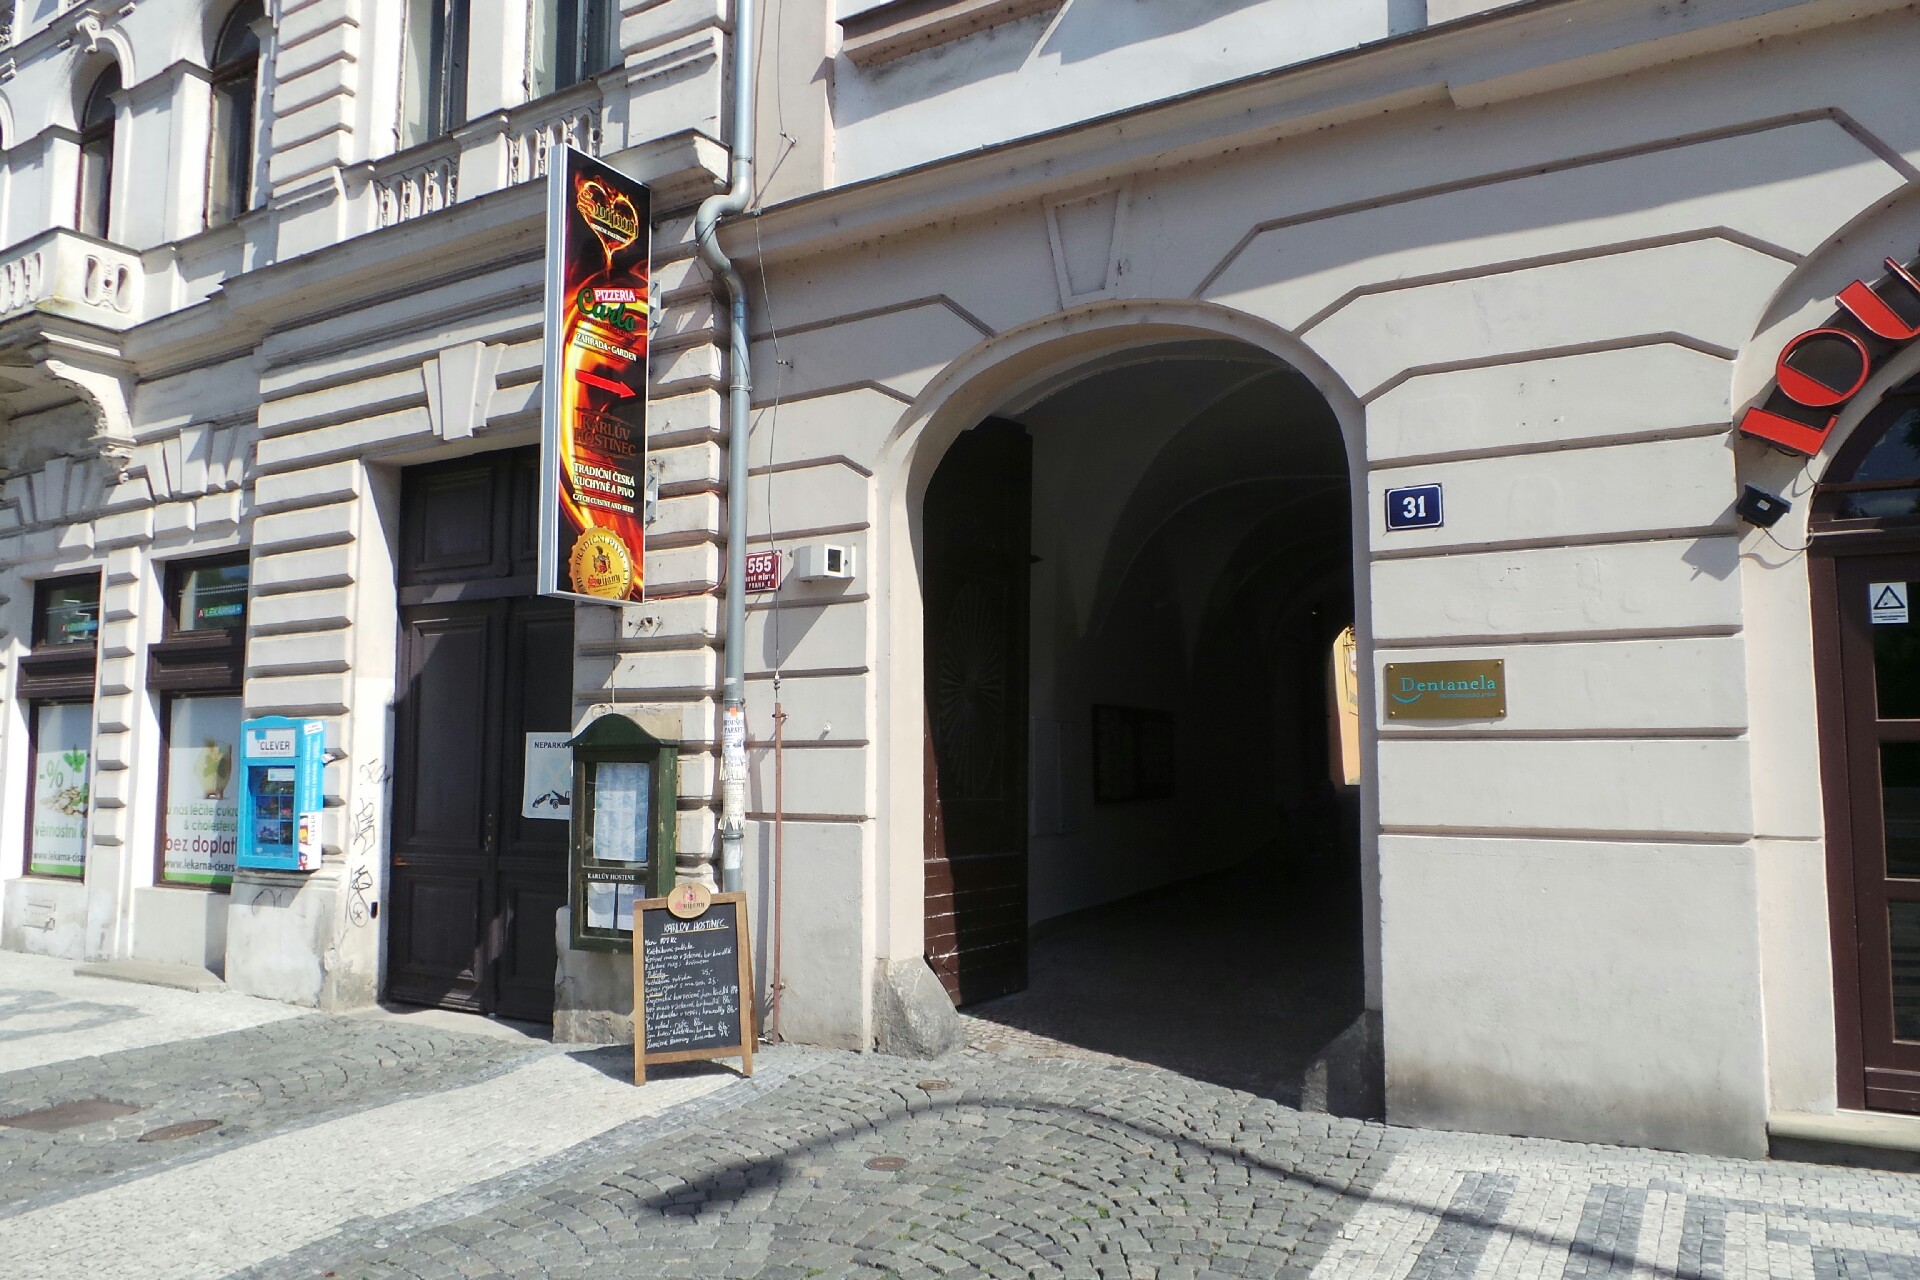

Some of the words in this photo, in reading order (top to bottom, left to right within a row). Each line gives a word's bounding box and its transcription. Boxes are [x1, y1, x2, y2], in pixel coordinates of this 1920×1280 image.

[594, 290, 635, 302] PIZZERIA
[578, 288, 635, 331] Carlo
[577, 332, 608, 351] ZAHRADA
[611, 346, 637, 362] GARDEN
[583, 416, 630, 440] KARLŮV
[575, 429, 636, 455] HOSTINEC
[574, 463, 612, 480] TRADIČNÍ
[613, 471, 635, 486] ČESKÁ
[574, 475, 610, 492] KUCHYNĚ
[611, 485, 616, 493] A
[617, 486, 635, 498] PIVO
[1403, 495, 1426, 518] 31
[1400, 674, 1497, 692] Dentanela
[260, 741, 291, 750] CLEVER
